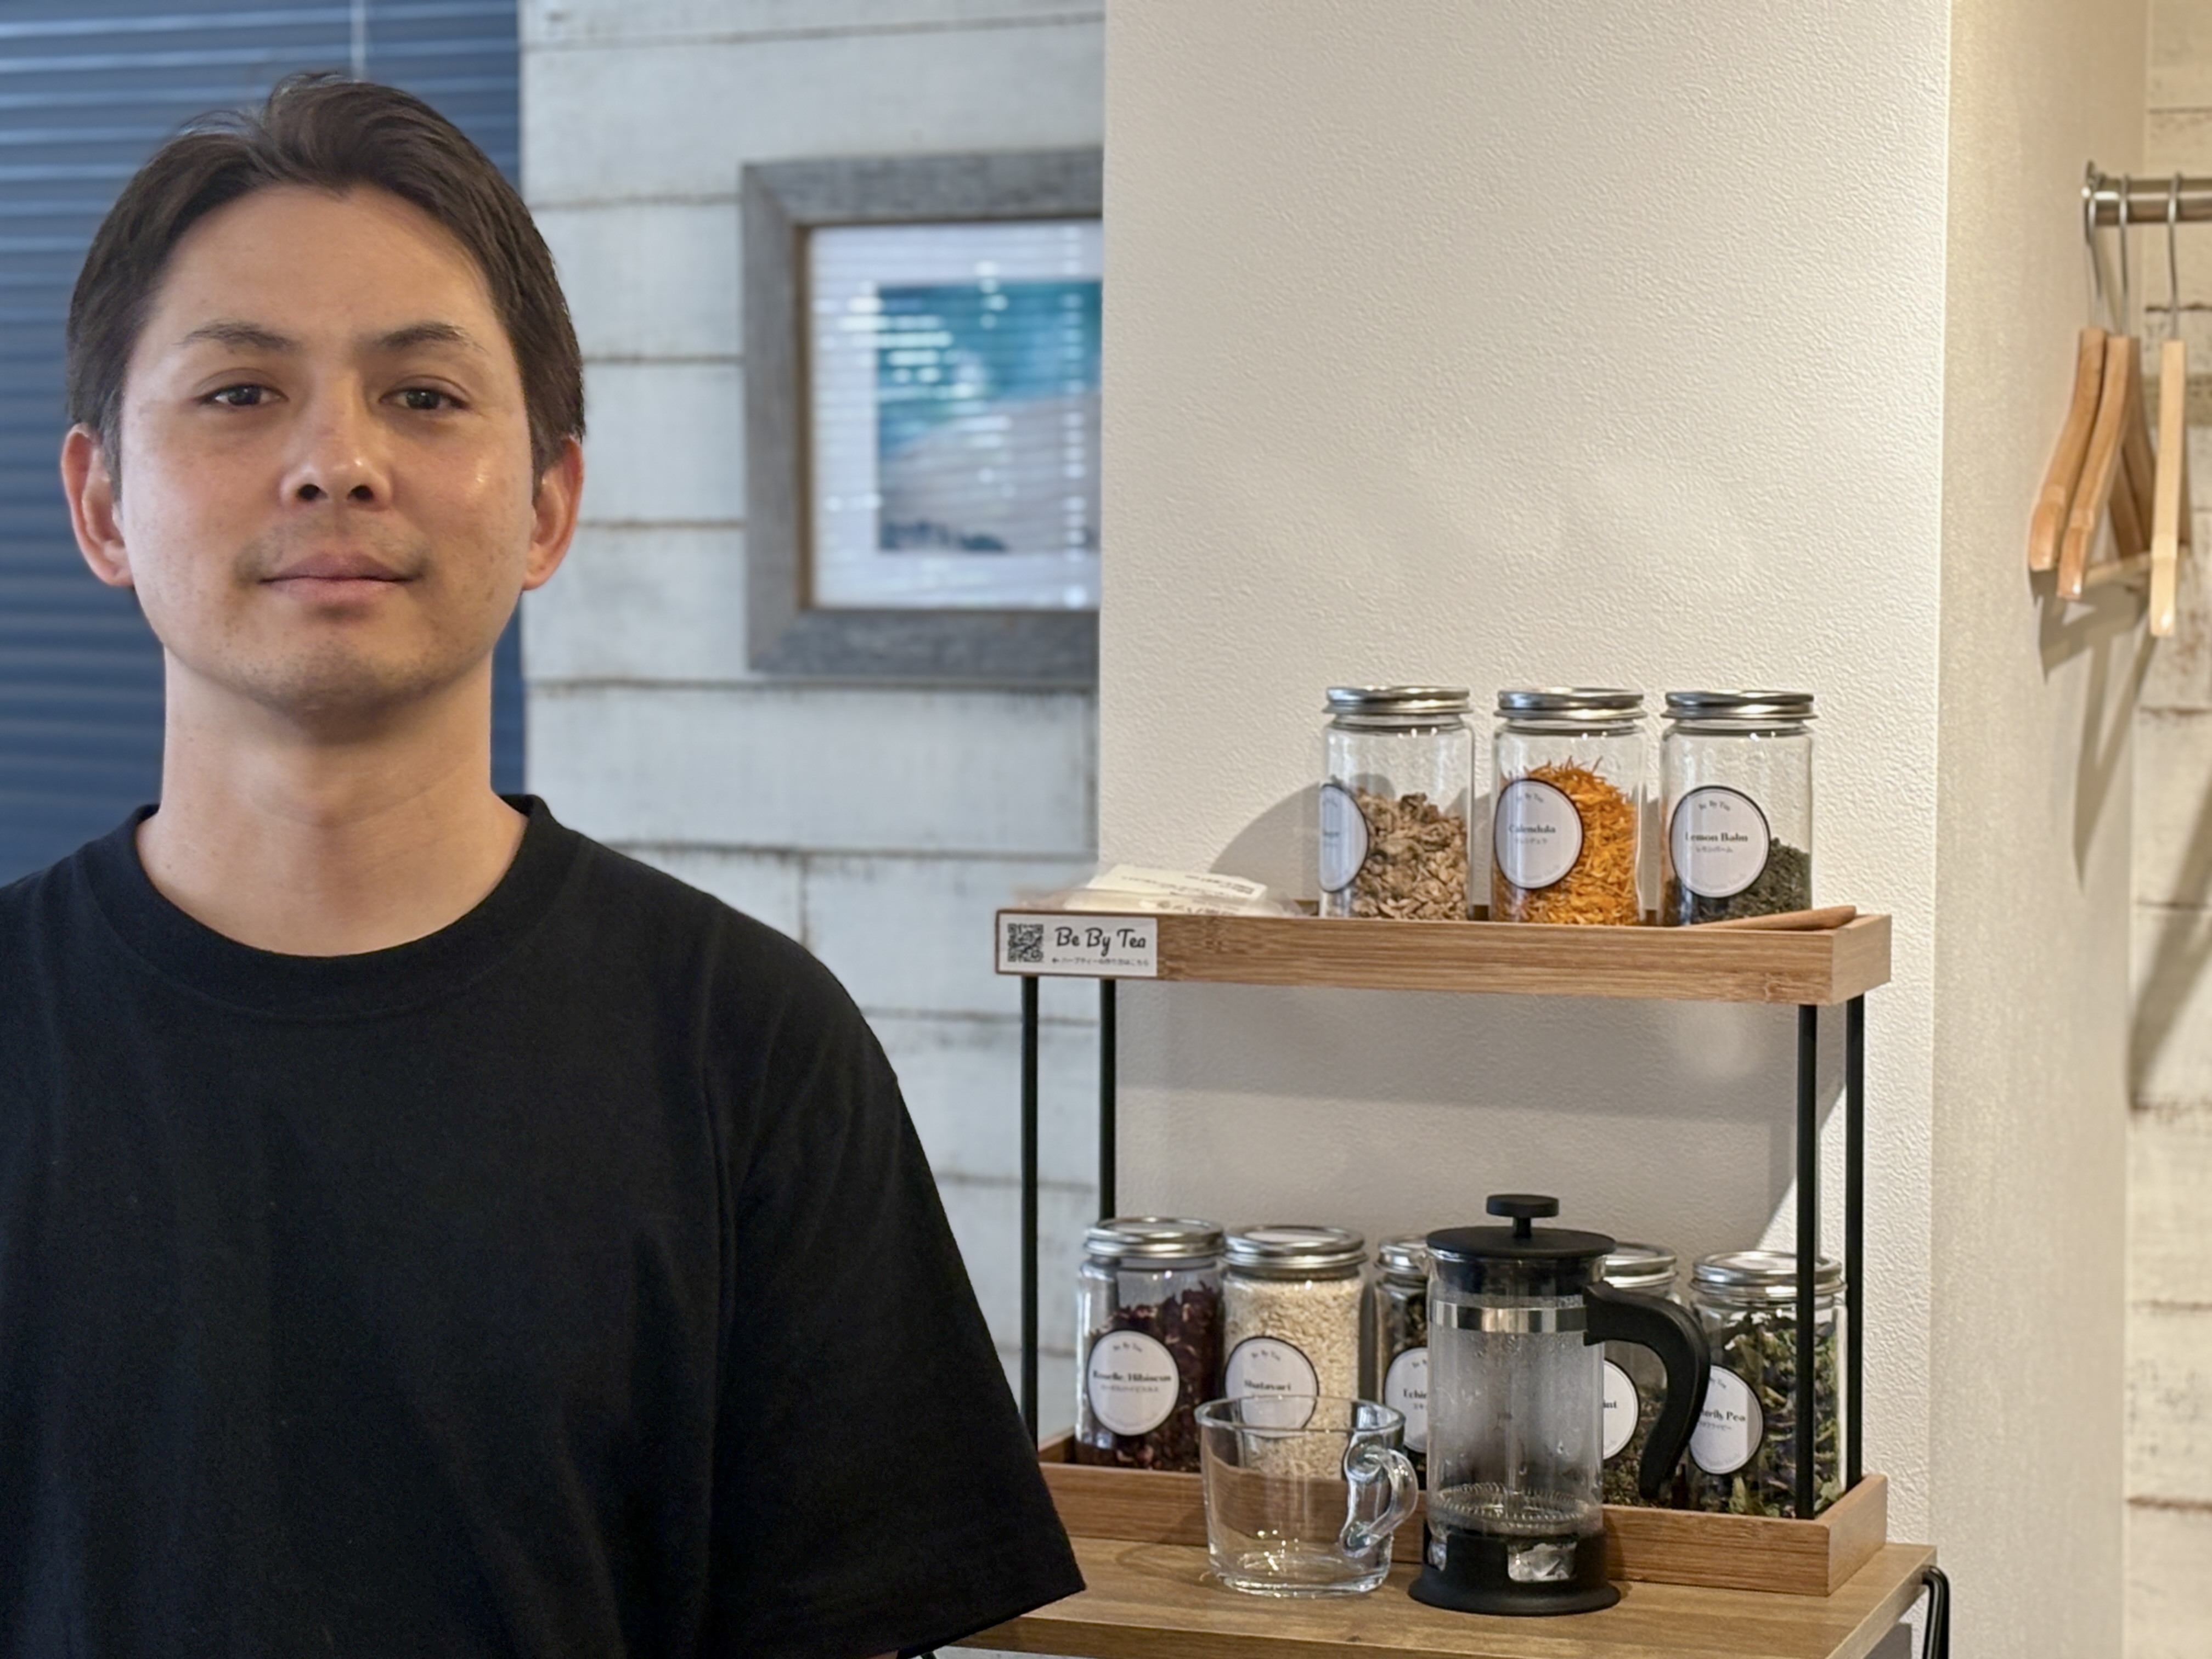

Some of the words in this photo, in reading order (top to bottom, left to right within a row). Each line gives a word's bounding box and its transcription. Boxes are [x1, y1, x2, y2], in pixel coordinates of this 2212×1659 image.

[1509, 824, 1556, 833] Calendula
[1685, 831, 1718, 842] Lemon
[1720, 831, 1748, 842] Balm
[1054, 926, 1080, 947] Be
[1085, 927, 1111, 957] By
[1117, 928, 1146, 949] Tea
[1127, 1373, 1172, 1382] Hibiscus
[1244, 1379, 1291, 1391] Shatavari
[1726, 1411, 1746, 1421] Pea
